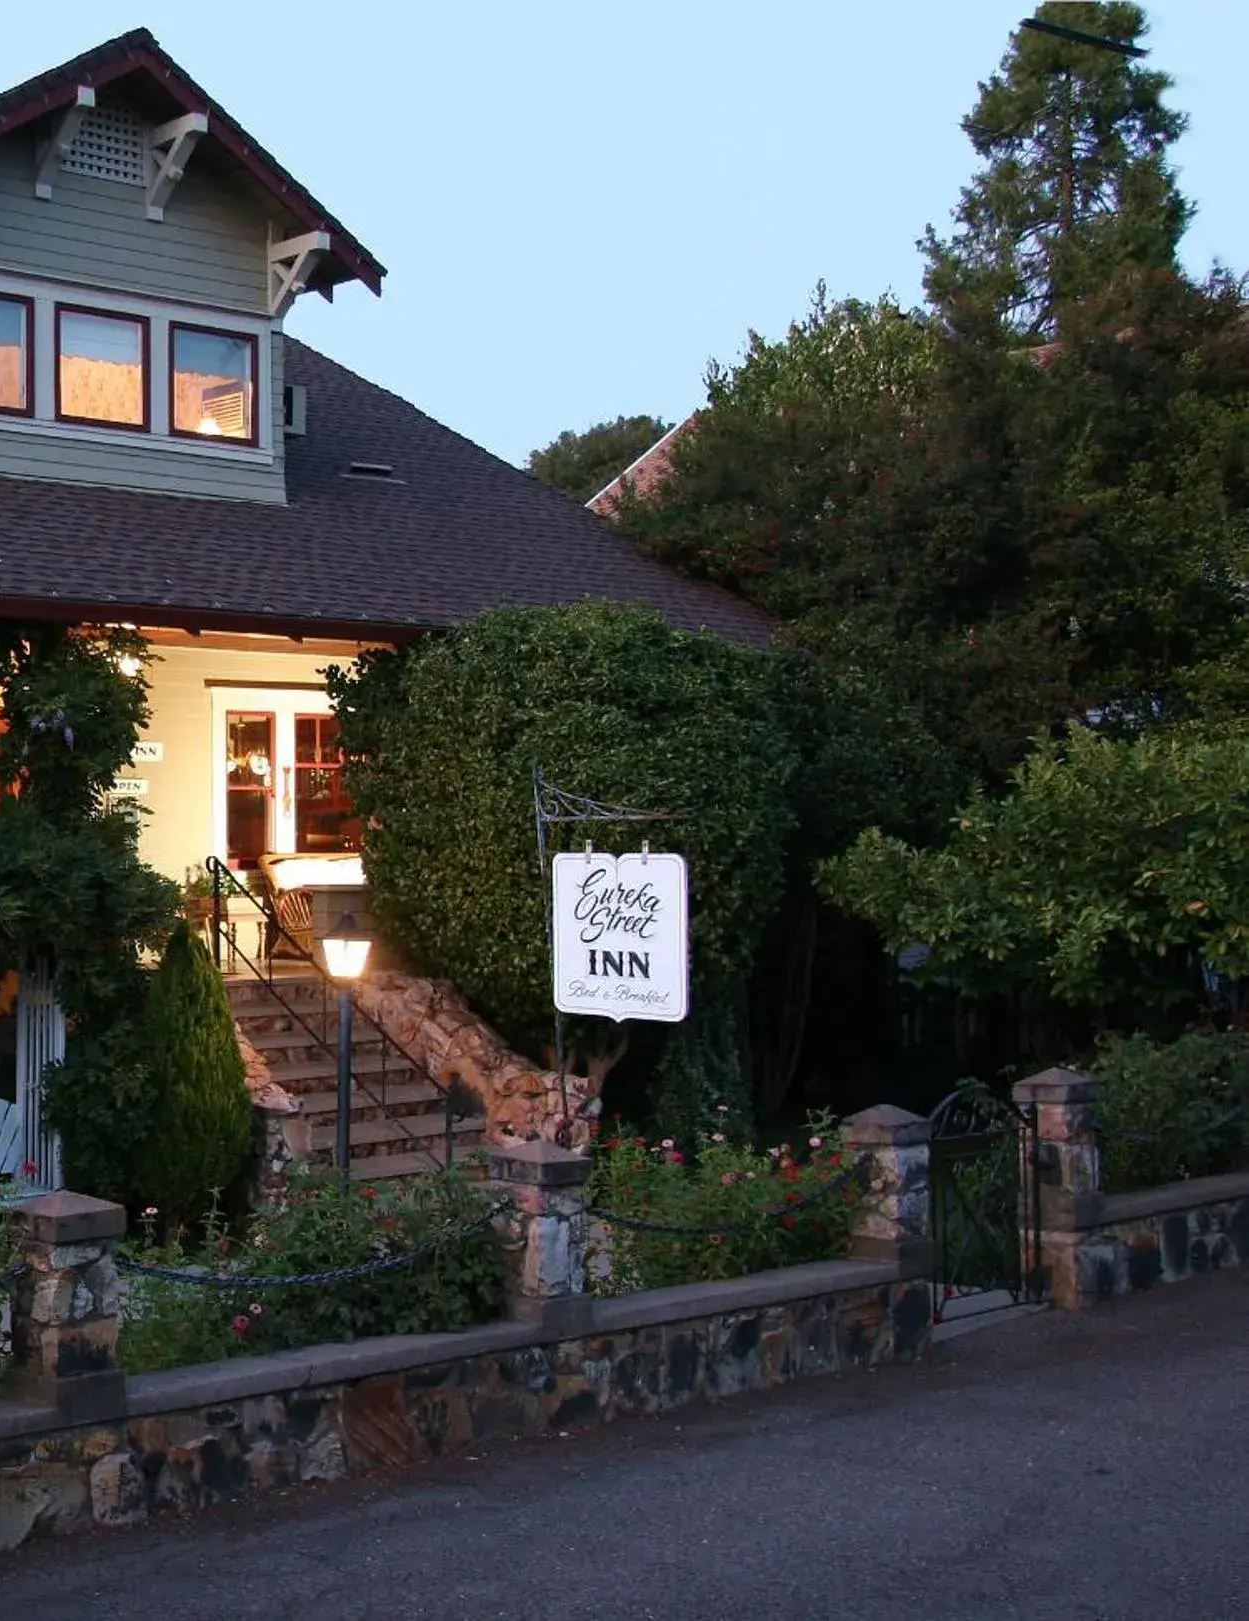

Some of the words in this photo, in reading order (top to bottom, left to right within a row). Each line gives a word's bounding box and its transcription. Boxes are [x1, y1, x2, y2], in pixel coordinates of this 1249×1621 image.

[135, 746, 157, 756] INN
[574, 868, 663, 920] Eureka
[580, 906, 658, 943] Street
[588, 949, 650, 979] INN
[567, 979, 600, 998] Bed
[614, 984, 670, 1008] Breakfast
